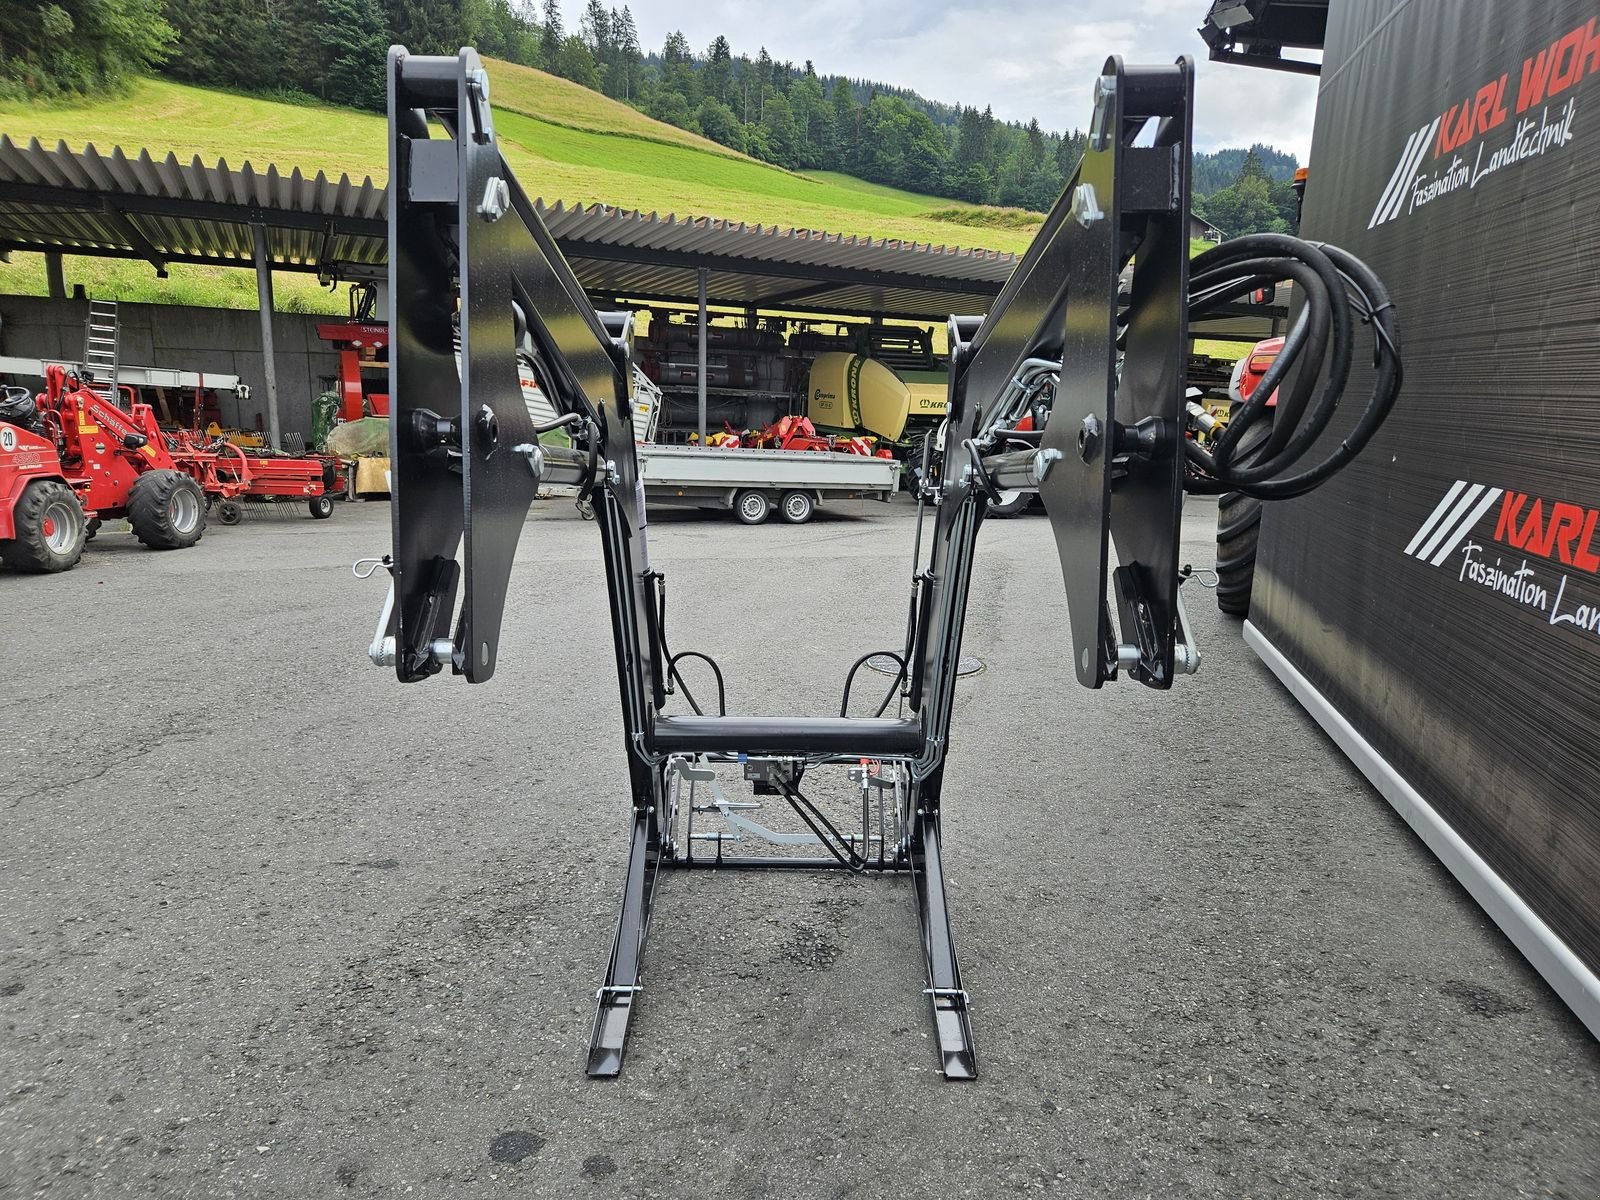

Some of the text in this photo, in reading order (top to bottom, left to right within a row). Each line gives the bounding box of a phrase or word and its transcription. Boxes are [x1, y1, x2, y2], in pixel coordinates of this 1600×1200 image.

[1434, 16, 1600, 160] KARL WOH
[1409, 97, 1575, 215] Faszination Landtechnik
[3, 431, 13, 446] 20
[90, 404, 128, 436] Schäffe
[1494, 490, 1600, 574] KARL
[1459, 540, 1547, 611] Faszination
